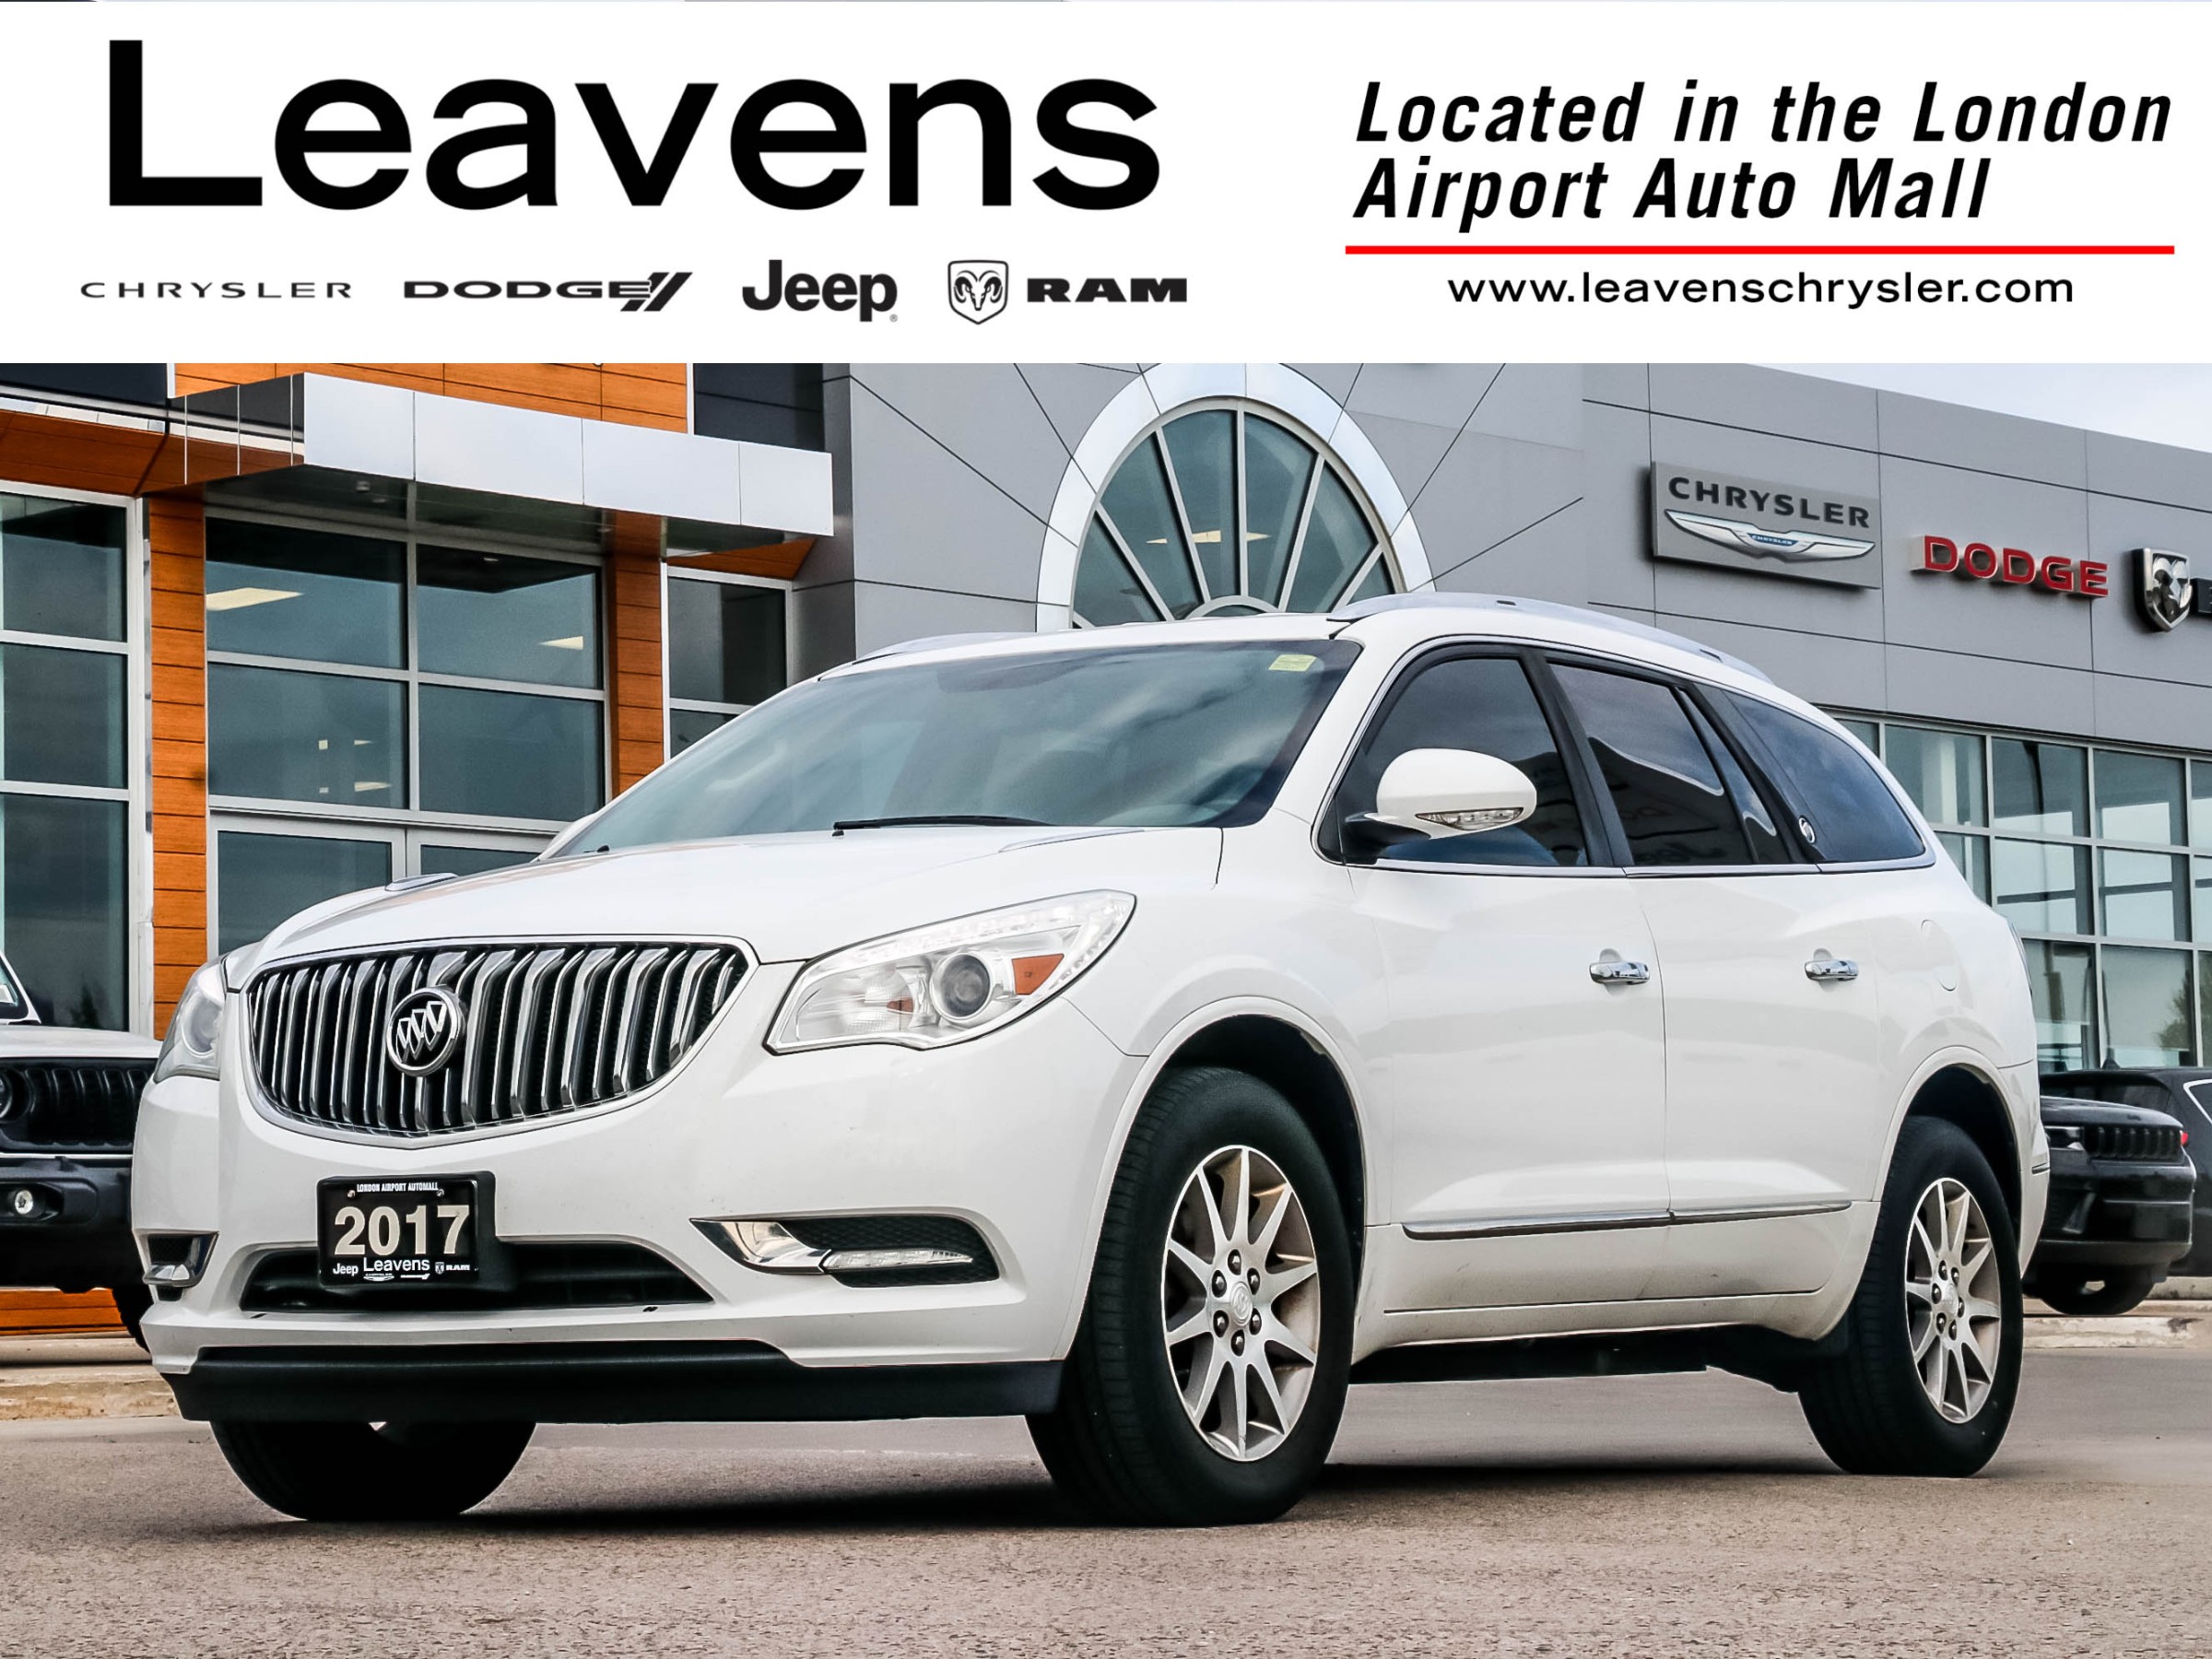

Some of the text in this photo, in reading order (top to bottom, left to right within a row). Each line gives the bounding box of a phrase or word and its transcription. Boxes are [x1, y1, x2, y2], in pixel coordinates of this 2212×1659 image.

[1668, 477, 1870, 528] CHRYSLER
[1924, 535, 2109, 597] DODGE
[381, 1182, 407, 1192] AIRPORT
[335, 1205, 469, 1256] 2017
[332, 1263, 359, 1277] Jeep
[363, 1256, 430, 1272] Leavens
